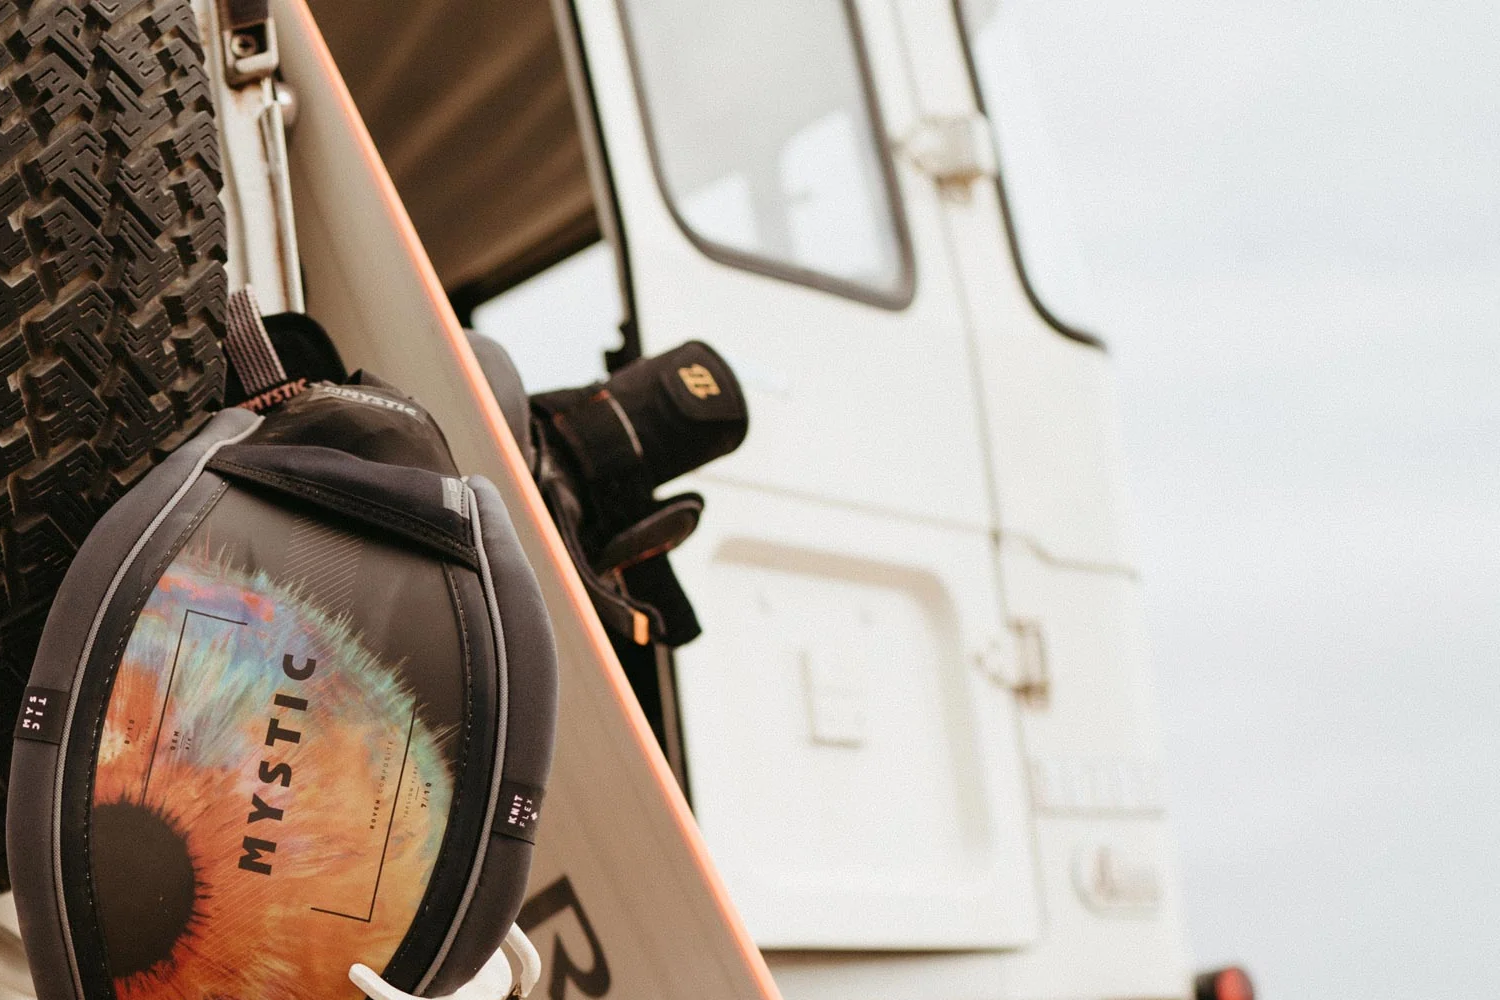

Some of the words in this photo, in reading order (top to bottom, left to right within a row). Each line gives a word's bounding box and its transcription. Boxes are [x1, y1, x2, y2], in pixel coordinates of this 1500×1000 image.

[250, 378, 307, 412] MYSTIC
[345, 388, 417, 416] MYSTIC
[22, 696, 37, 728] MYS
[238, 653, 317, 876] MYSTIC
[508, 794, 523, 824] KNIT
[519, 799, 532, 827] FLEX
